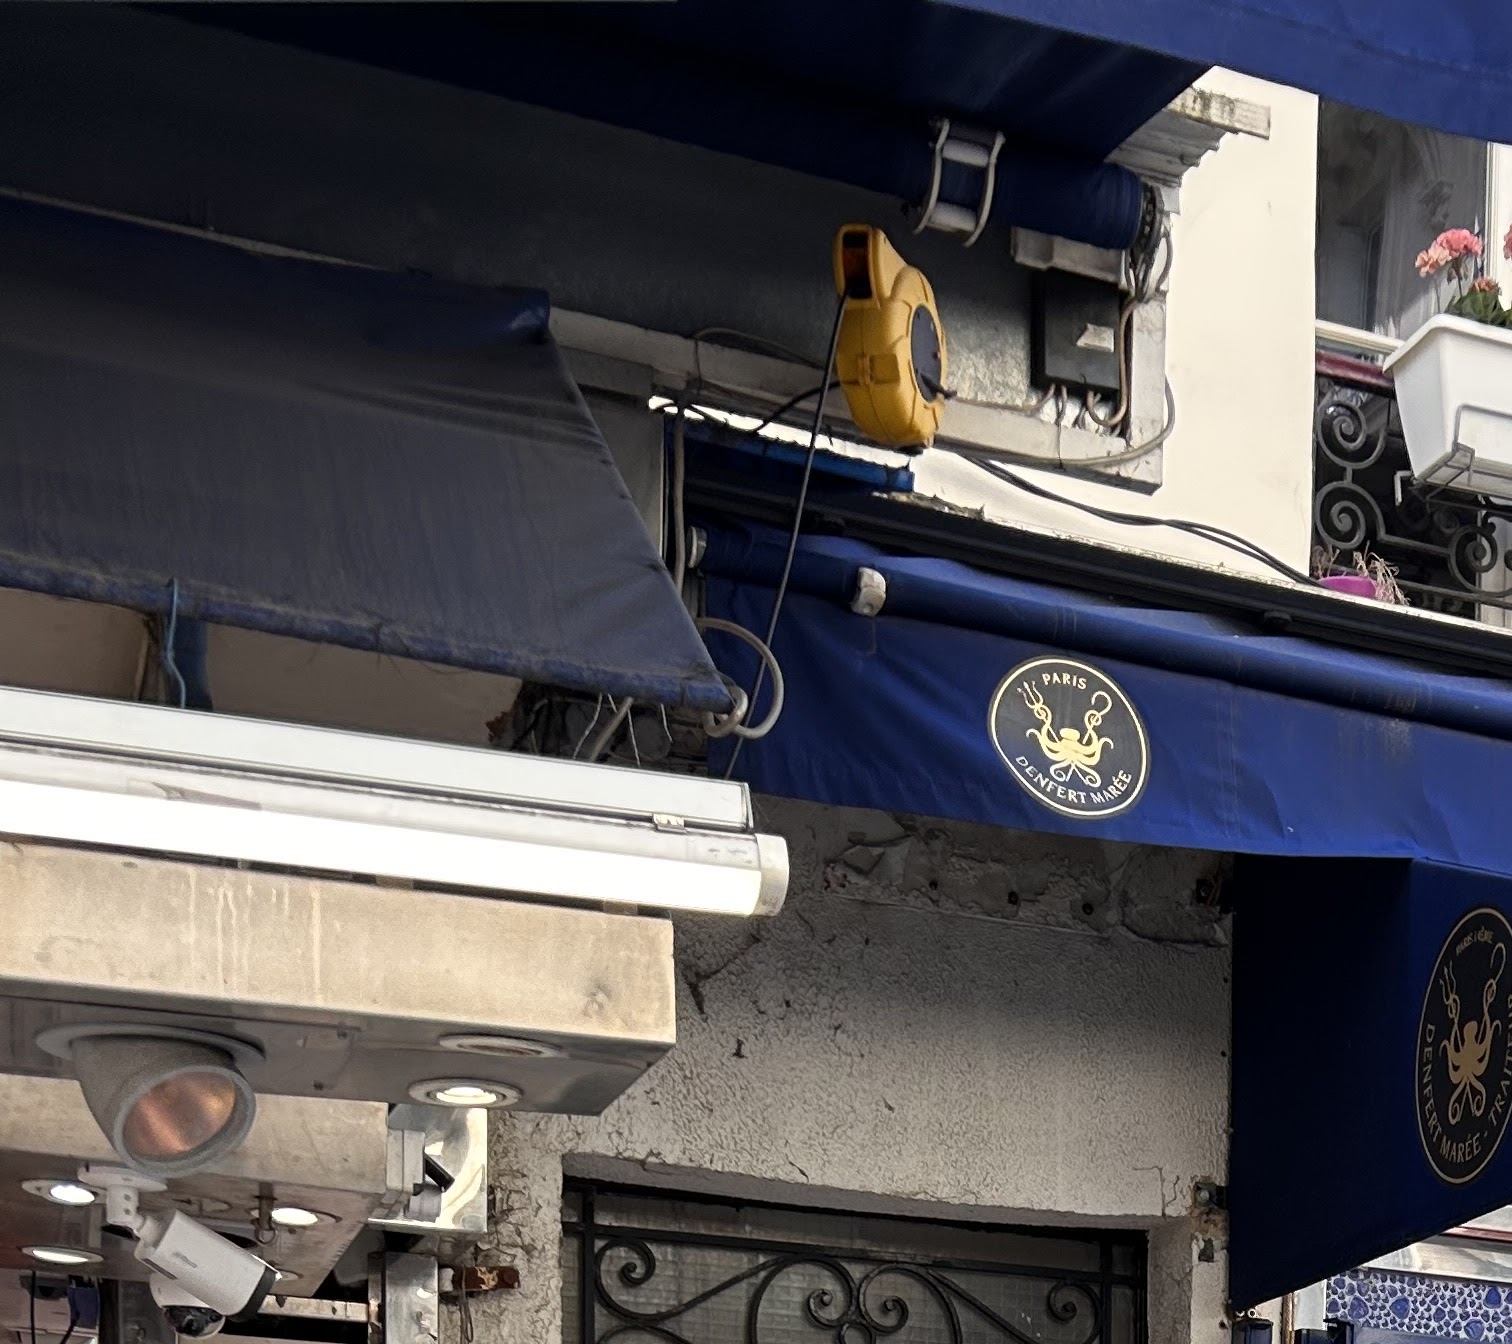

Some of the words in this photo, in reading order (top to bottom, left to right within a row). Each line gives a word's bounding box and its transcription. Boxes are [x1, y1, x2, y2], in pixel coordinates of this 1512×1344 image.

[1042, 672, 1087, 690] PARIS
[1016, 756, 1086, 804] DENFERT
[1090, 769, 1132, 805] MARÉE
[1423, 1024, 1442, 1142] DENFERT
[1440, 1133, 1481, 1163] MARÉE
